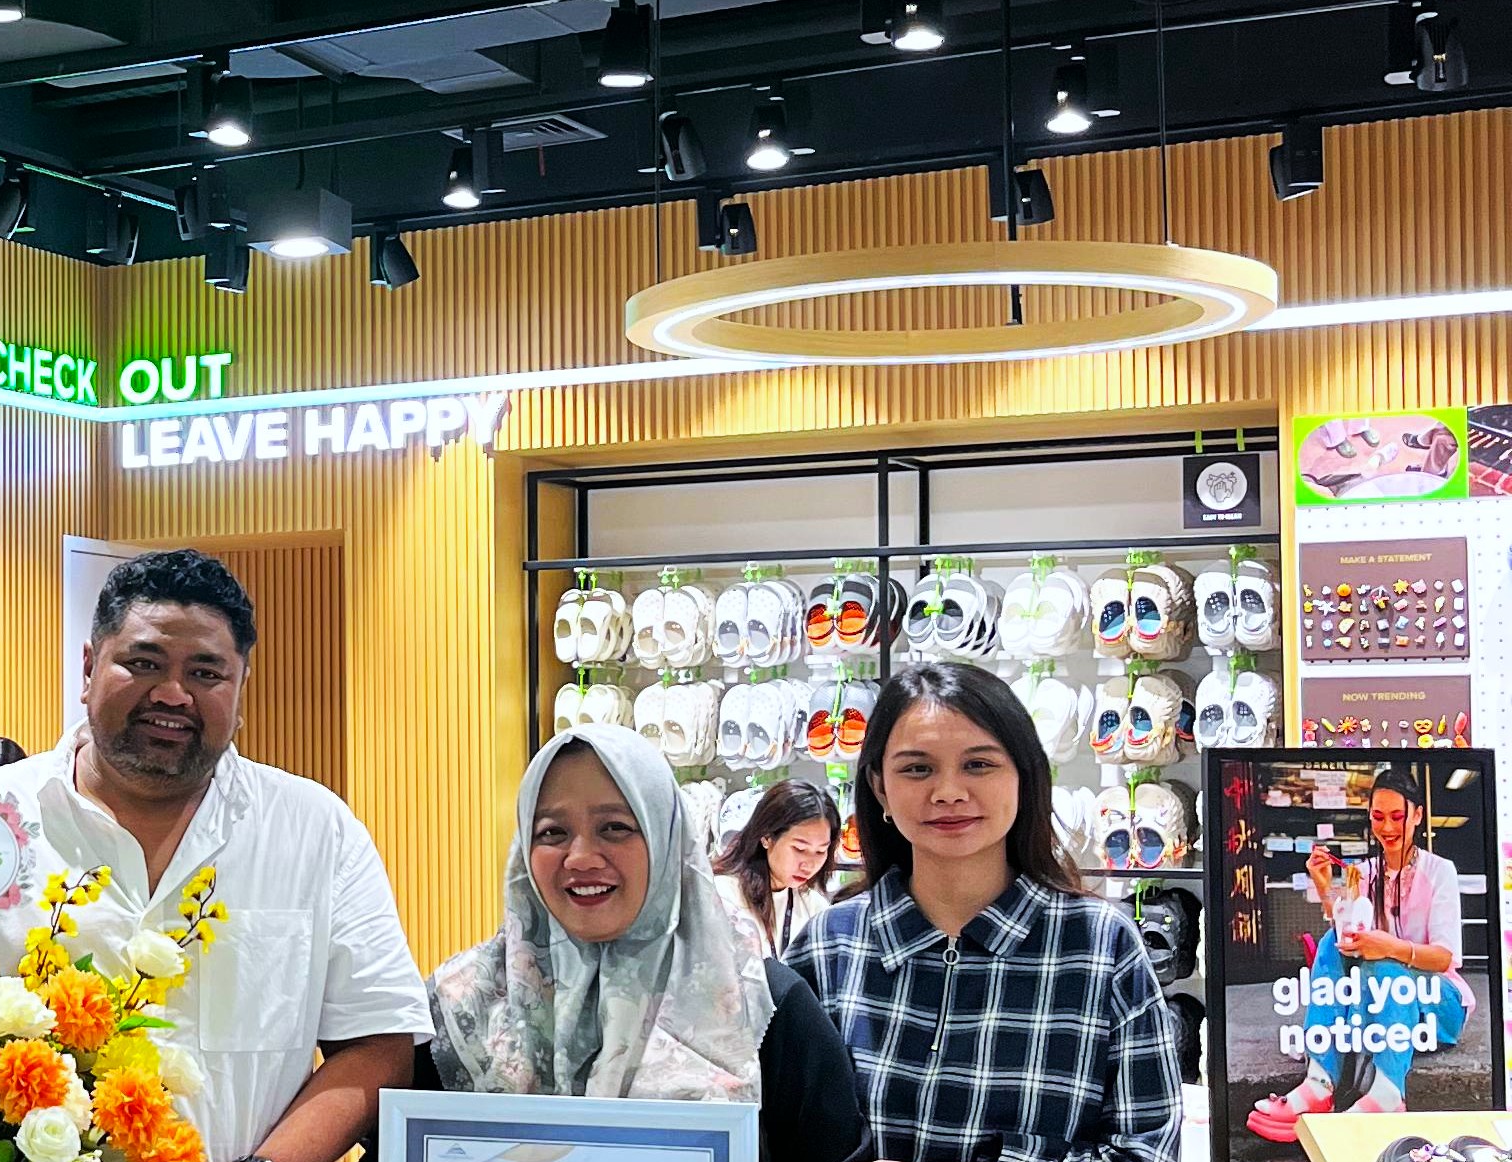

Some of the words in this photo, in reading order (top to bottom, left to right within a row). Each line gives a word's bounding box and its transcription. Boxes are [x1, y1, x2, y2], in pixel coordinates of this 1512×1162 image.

[119, 352, 232, 404] OUT
[121, 410, 288, 468] LEAVE
[304, 395, 507, 456] HAPPY
[1340, 556, 1367, 564] MAKE
[1377, 553, 1433, 563] STATEMENT
[1342, 692, 1369, 701] NOW
[1371, 691, 1426, 701] TRENDING
[1273, 965, 1361, 1015] glad
[1367, 975, 1441, 1014] you
[1279, 1012, 1438, 1054] noticed
